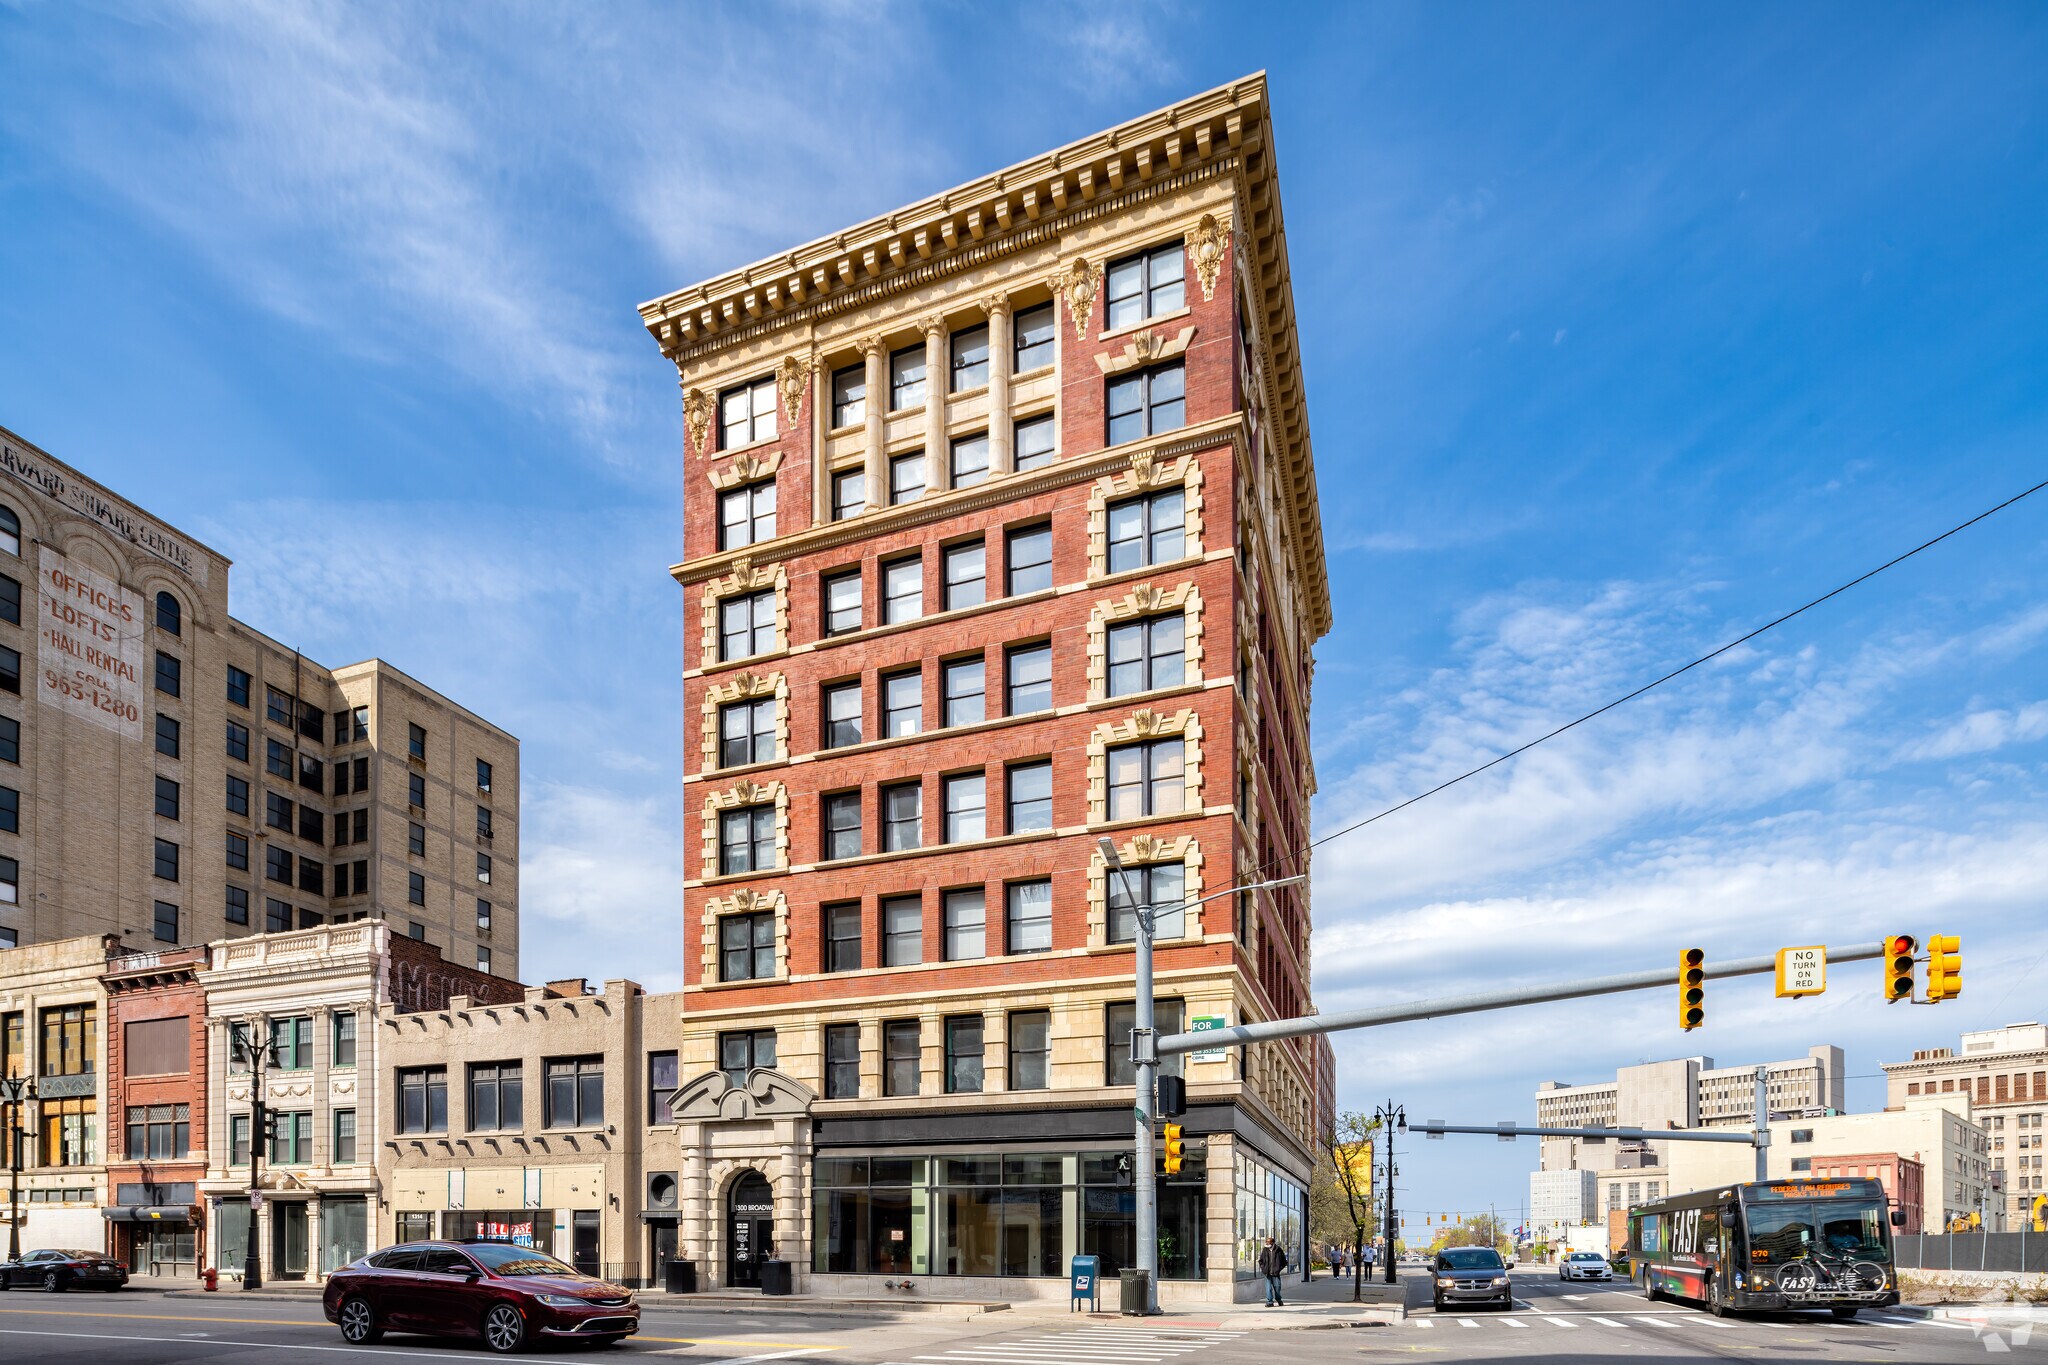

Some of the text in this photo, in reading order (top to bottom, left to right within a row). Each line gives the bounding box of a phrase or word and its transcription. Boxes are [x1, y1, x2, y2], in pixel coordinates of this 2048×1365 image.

[0, 445, 65, 496] RVARD
[52, 570, 133, 622] OFFICES
[51, 597, 114, 642] LOFTS
[51, 629, 137, 684] HALL RENTAL
[45, 669, 138, 722] 963-1280
[1795, 951, 1814, 960] NO
[1192, 1021, 1212, 1031] FOR
[500, 1221, 532, 1235] LASE
[1672, 1208, 1701, 1253] FAST
[1781, 1276, 1815, 1289] FAST
